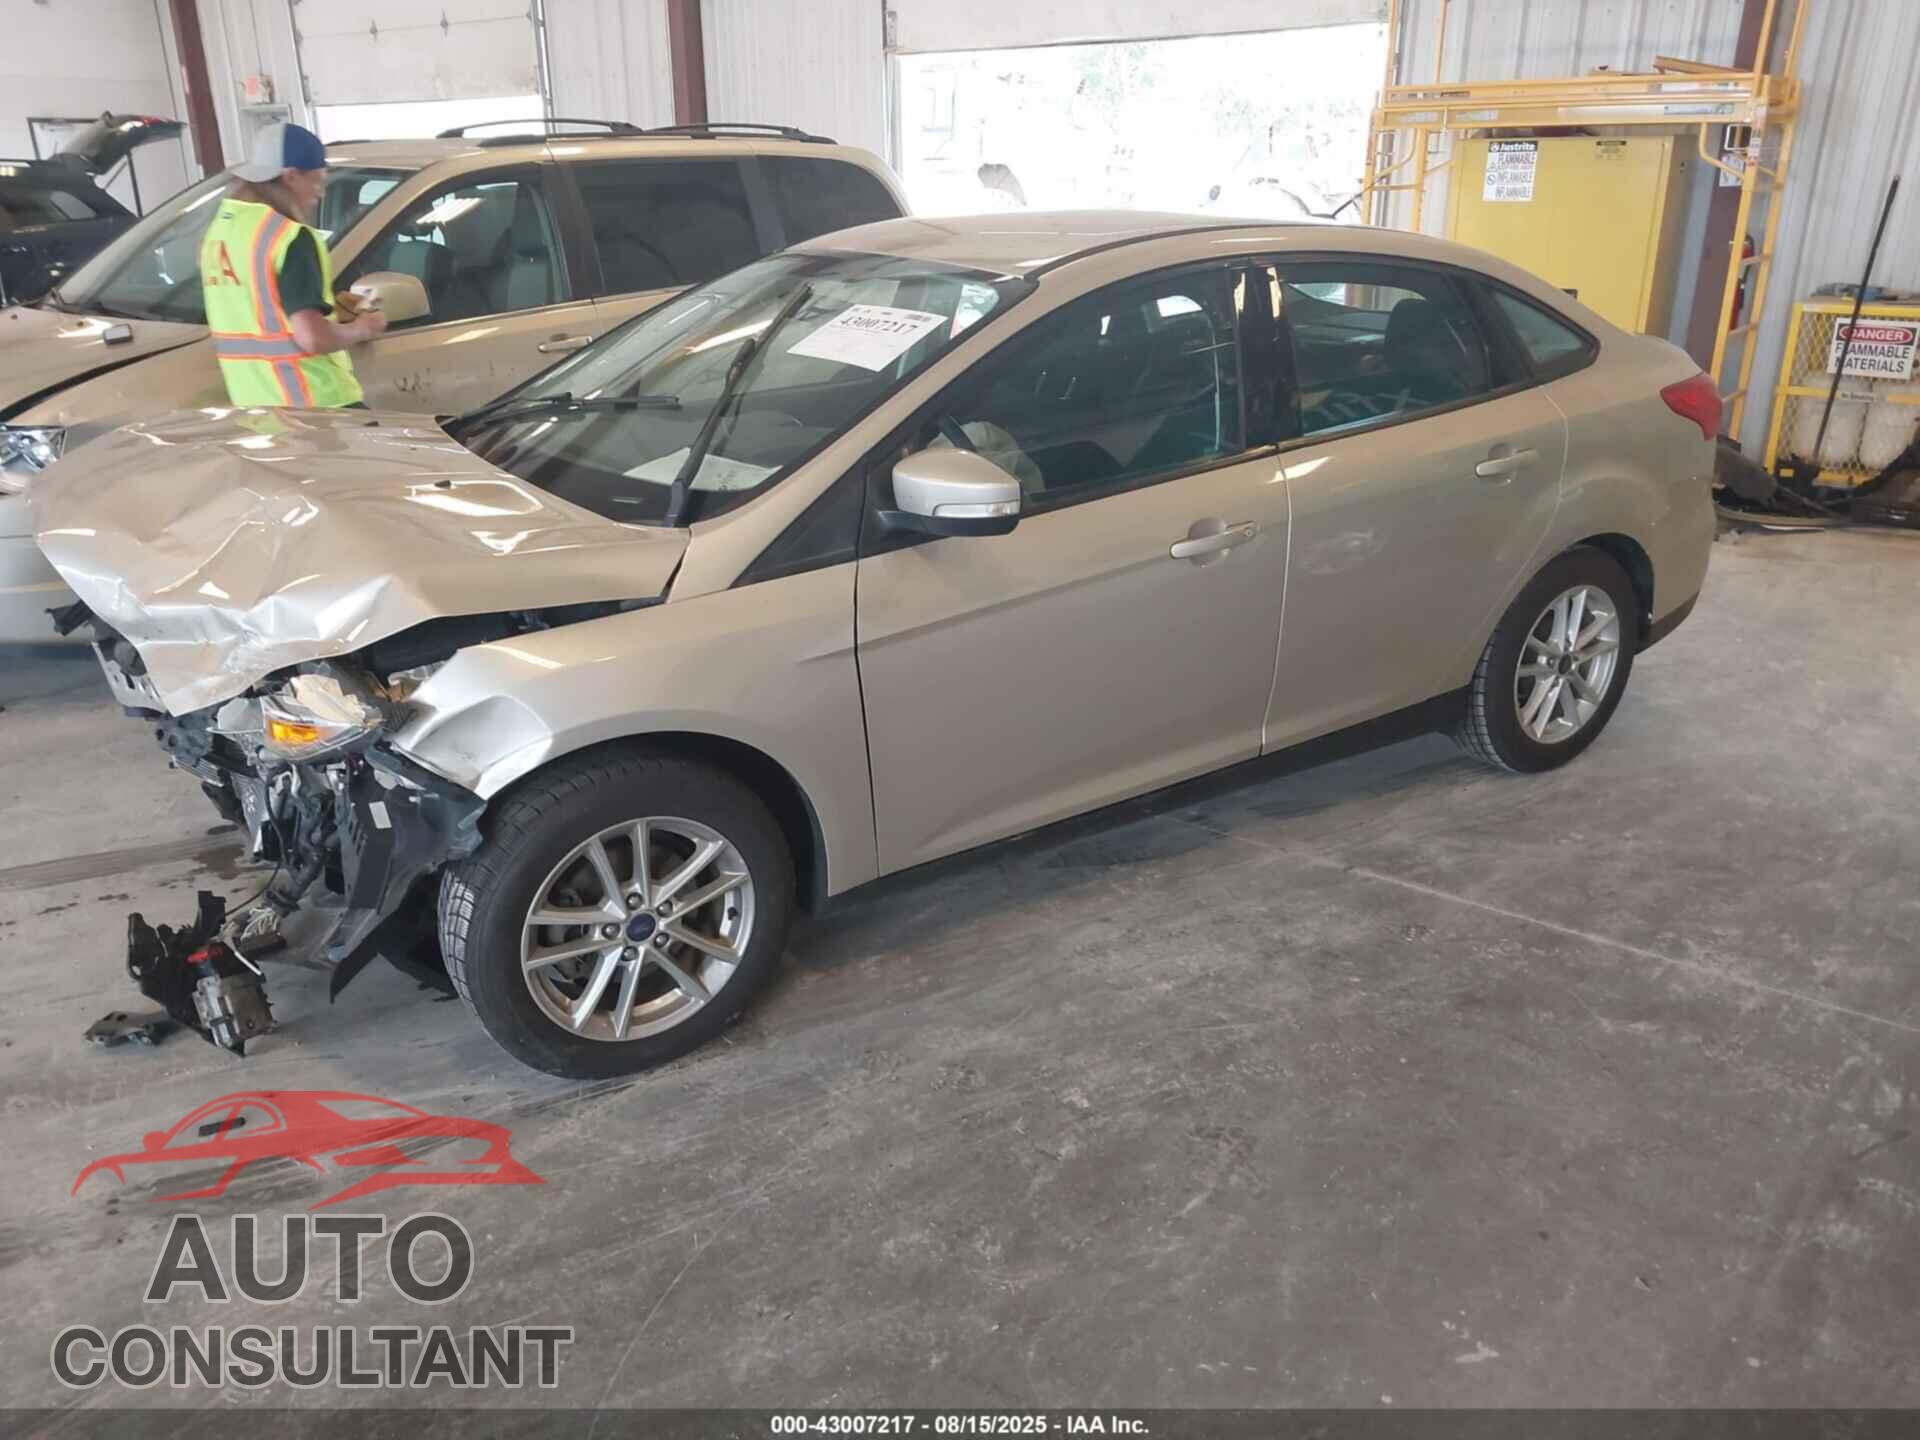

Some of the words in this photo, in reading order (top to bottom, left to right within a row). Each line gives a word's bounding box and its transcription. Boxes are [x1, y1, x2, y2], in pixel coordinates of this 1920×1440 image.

[1500, 142, 1536, 151] Justrite
[840, 316, 918, 335] 43007217
[1835, 342, 1910, 359] FAMMABLE
